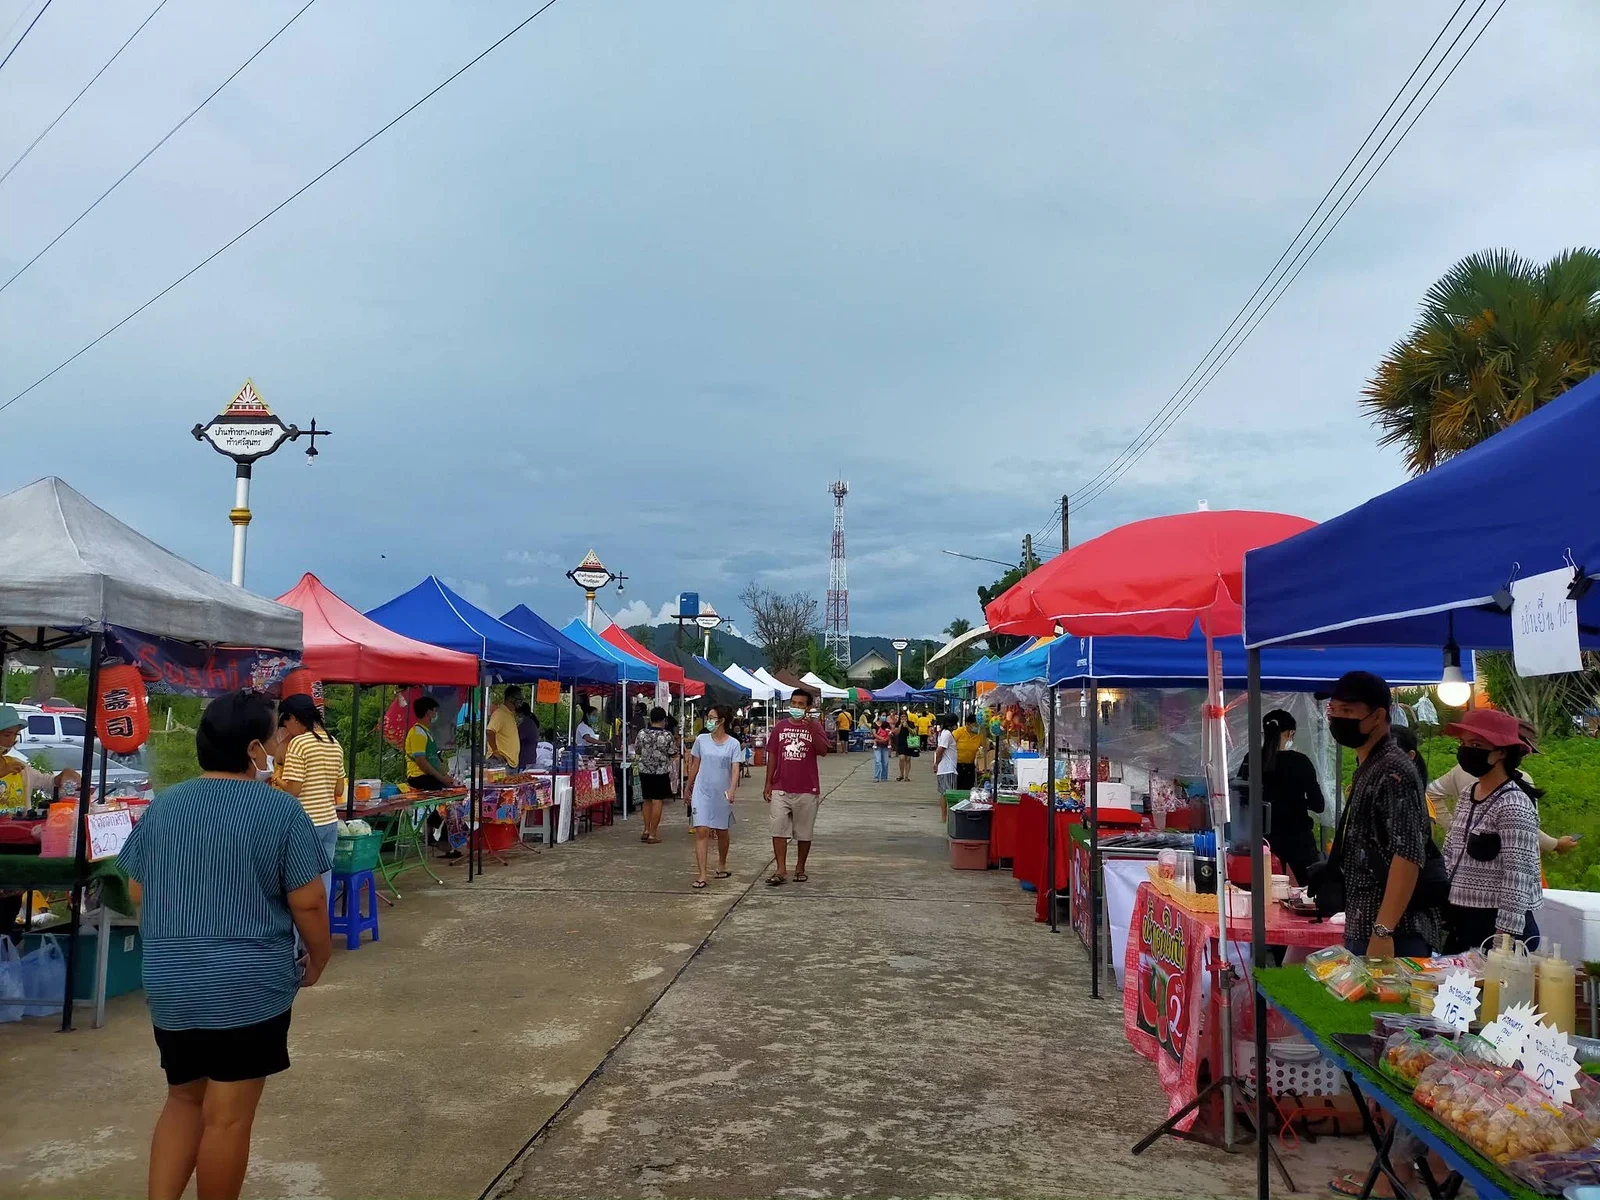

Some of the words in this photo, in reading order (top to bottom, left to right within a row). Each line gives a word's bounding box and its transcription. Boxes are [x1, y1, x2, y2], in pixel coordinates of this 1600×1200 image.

[138, 643, 239, 690] Sushi
[779, 732, 799, 742] BEVERLY
[799, 732, 813, 743] HILLS
